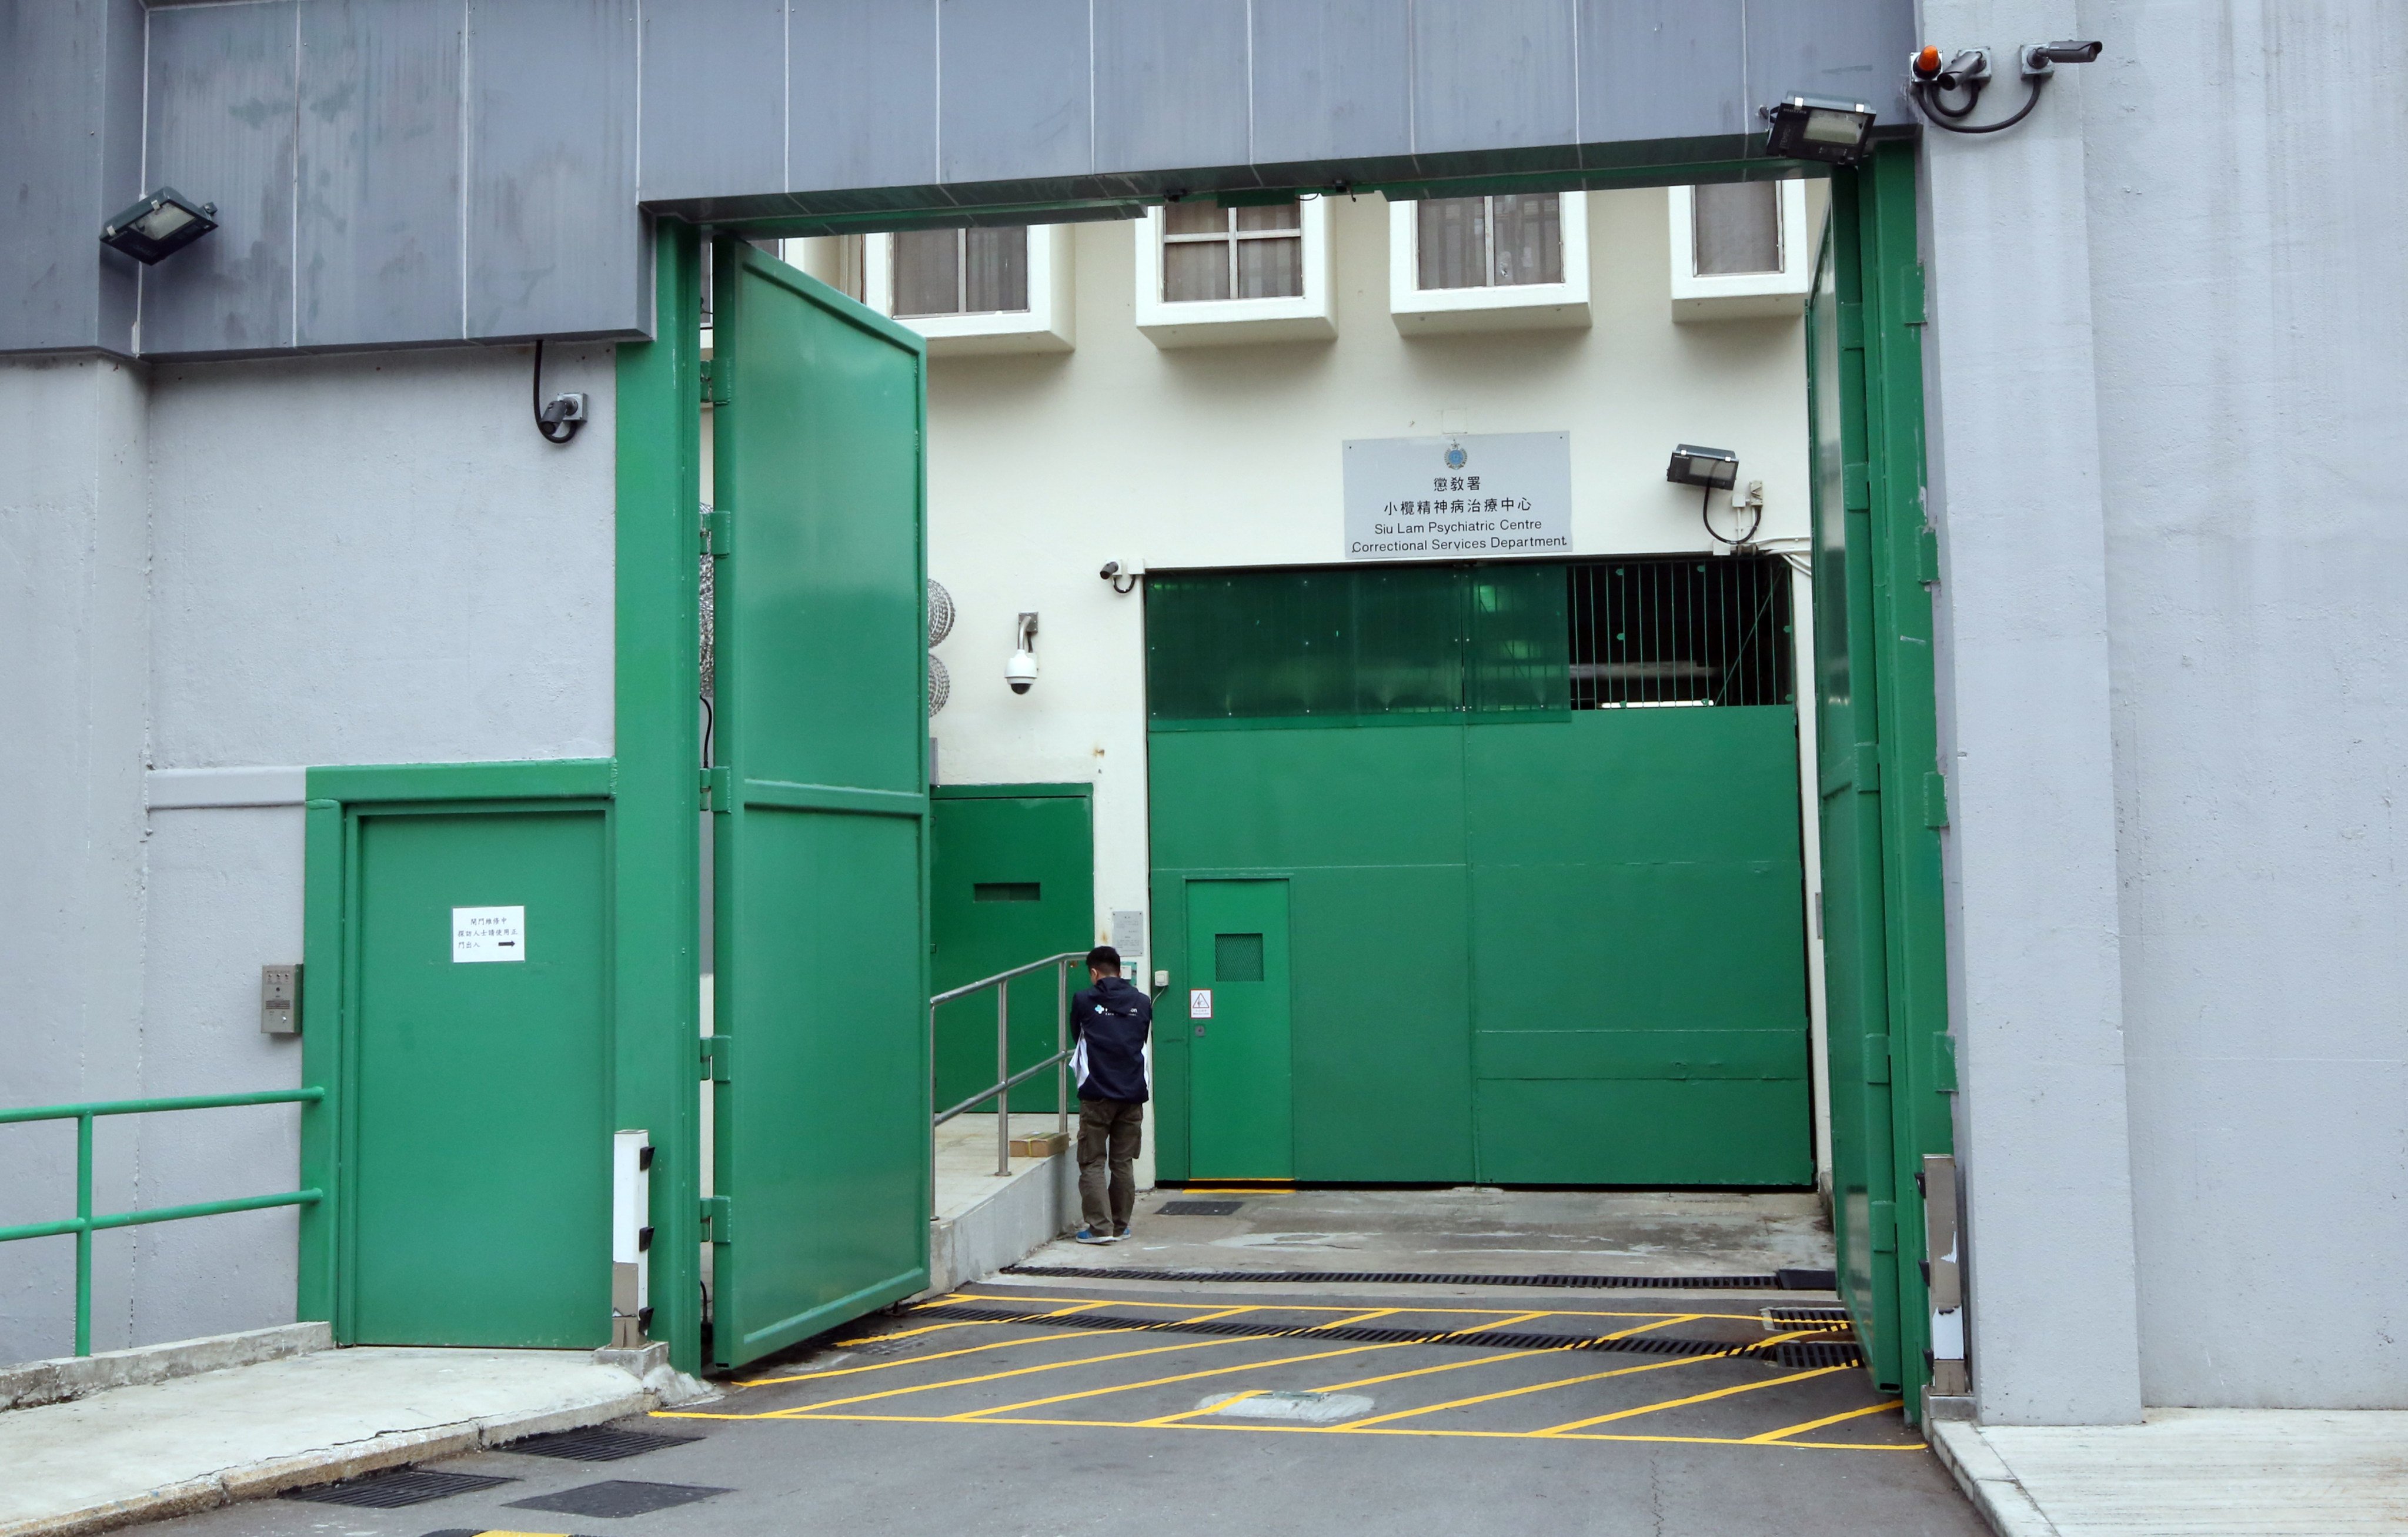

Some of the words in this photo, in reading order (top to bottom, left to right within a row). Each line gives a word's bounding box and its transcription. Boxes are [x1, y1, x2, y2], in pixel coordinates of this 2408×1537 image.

[1384, 497, 1532, 516] 小欖精神病治療中心
[1375, 523, 1393, 534] Siu
[1397, 523, 1424, 534] Lam
[1428, 520, 1495, 535] Psychiatric
[1499, 519, 1542, 530] Centre
[1352, 540, 1427, 553] Correctional
[1431, 539, 1486, 550] Services
[1491, 536, 1567, 550] Department
